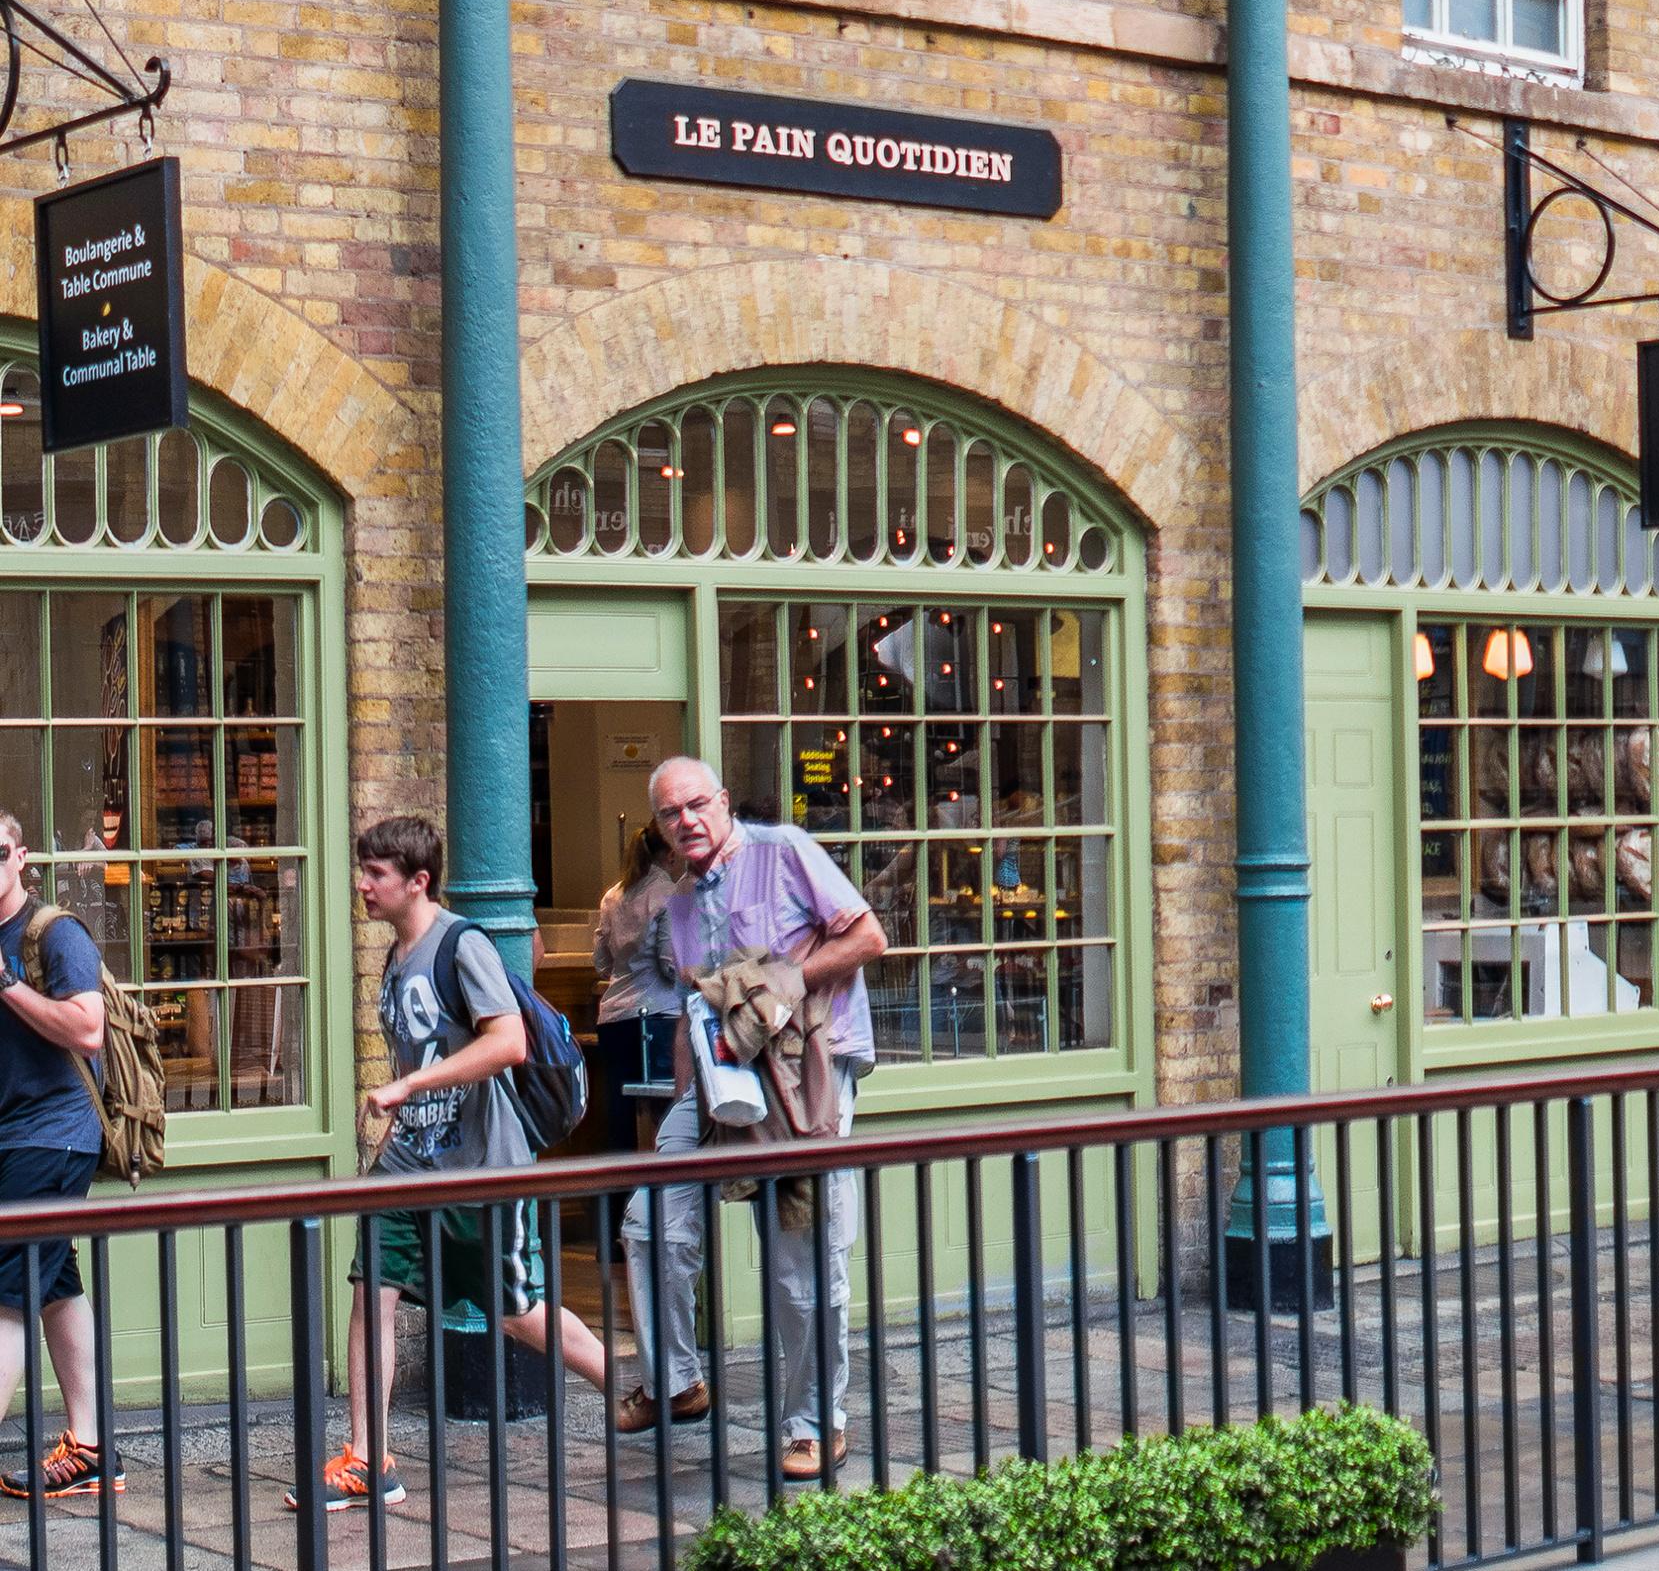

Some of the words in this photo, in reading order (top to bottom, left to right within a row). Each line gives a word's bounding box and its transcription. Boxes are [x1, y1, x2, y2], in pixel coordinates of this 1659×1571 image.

[673, 114, 722, 149] LE
[731, 121, 816, 159] PAIN
[825, 131, 1014, 183] QUOTIDIEN
[65, 229, 133, 268] Boulangerie
[134, 224, 146, 247] &
[61, 272, 91, 300] Table
[92, 259, 152, 292] Commune
[82, 323, 121, 351] Bakery
[122, 317, 134, 341] &
[62, 352, 124, 387] Communal
[125, 344, 157, 373] Table
